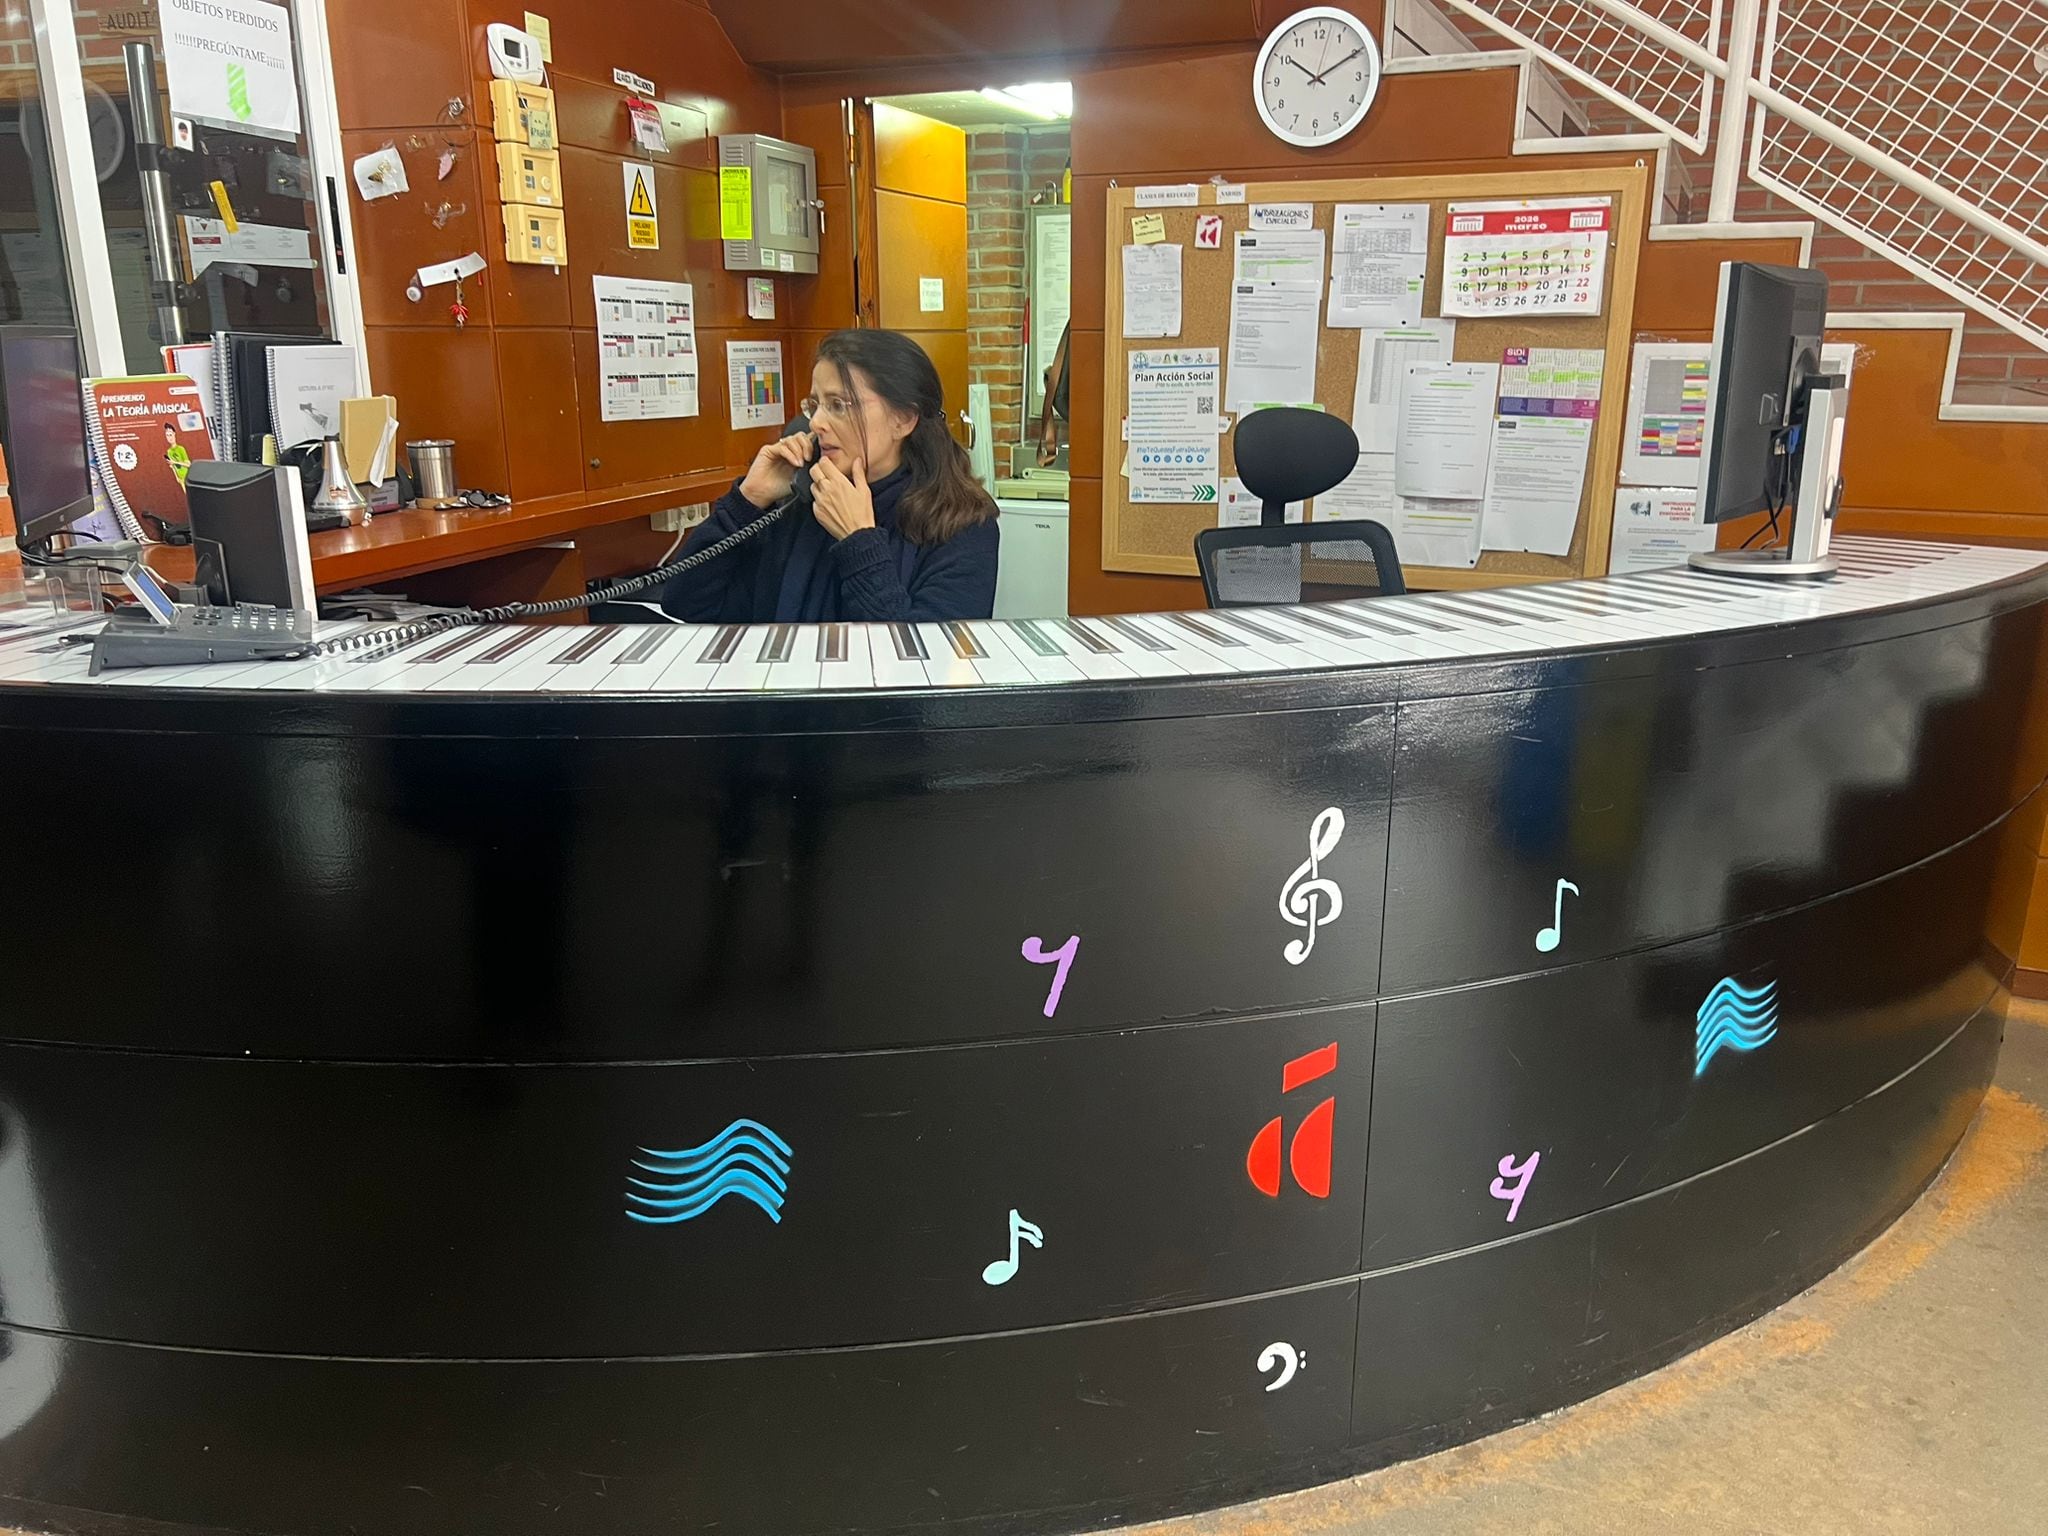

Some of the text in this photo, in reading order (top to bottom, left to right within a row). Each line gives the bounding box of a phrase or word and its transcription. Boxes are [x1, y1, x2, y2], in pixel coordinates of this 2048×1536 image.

[173, 0, 278, 33] OBJETOS PERDIDOS
[1314, 29, 1326, 40] 12
[1337, 34, 1342, 44] 1
[1294, 38, 1304, 48] 11
[1280, 55, 1292, 65] 10
[1273, 77, 1280, 87] 9
[1355, 72, 1362, 82] 3
[1278, 99, 1284, 109] 8
[1348, 94, 1355, 104] 4
[1292, 114, 1300, 124] 7
[1332, 112, 1340, 122] 5
[1312, 118, 1319, 128] 6
[1514, 215, 1540, 223] 2026
[1505, 223, 1548, 231] marzo
[1587, 233, 1592, 242] 1
[1463, 249, 1590, 262] 2 3 4 5 6 7 8
[1461, 264, 1591, 277] 9 10 11 12 13 14 15
[1458, 278, 1589, 292] 16 17 18 19 20 21 22
[1495, 297, 1507, 306] 25
[1514, 296, 1527, 306] 26
[1533, 295, 1546, 304] 27
[1553, 294, 1566, 303] 28
[1574, 293, 1587, 302] 29
[1135, 371, 1214, 382] Plan Acción Social
[101, 394, 146, 404] APRENDIENDO
[103, 402, 191, 418] LA TEORÍA MUSICAL
